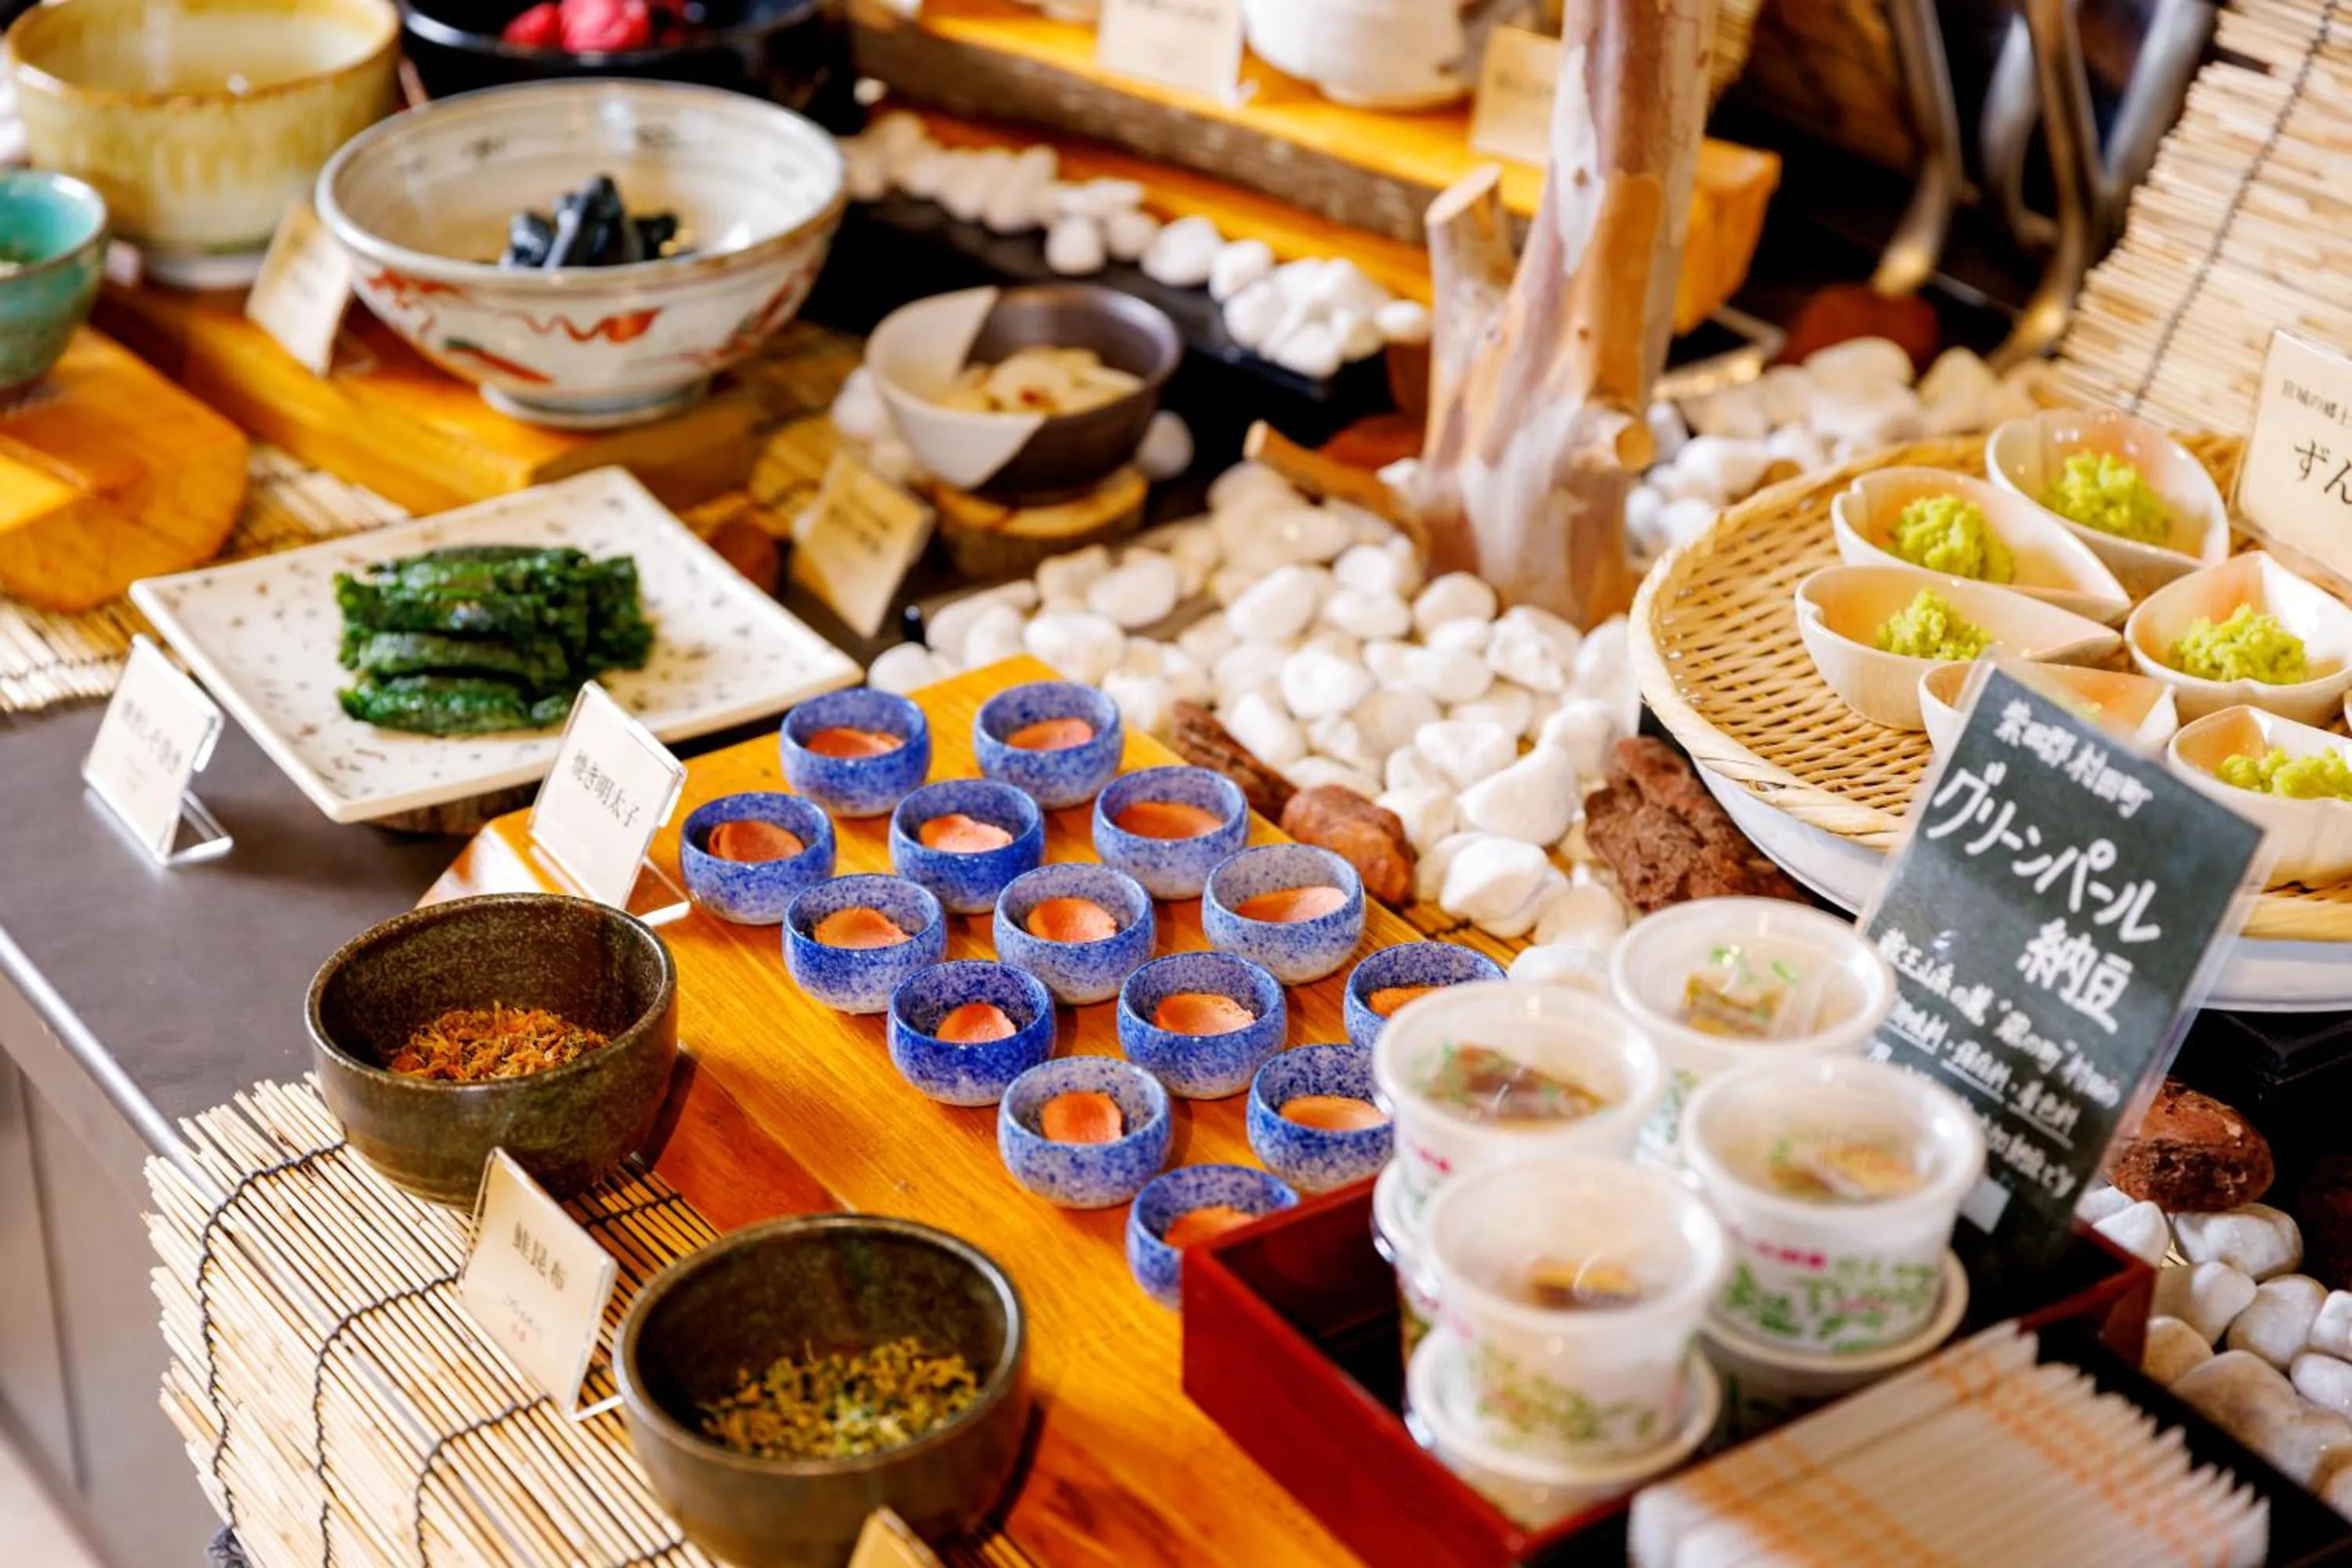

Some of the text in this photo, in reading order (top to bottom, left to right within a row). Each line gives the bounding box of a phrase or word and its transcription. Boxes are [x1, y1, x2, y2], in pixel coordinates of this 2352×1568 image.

[1927, 761, 2161, 942] グリーンパール
[2015, 916, 2134, 1034] 納豆
